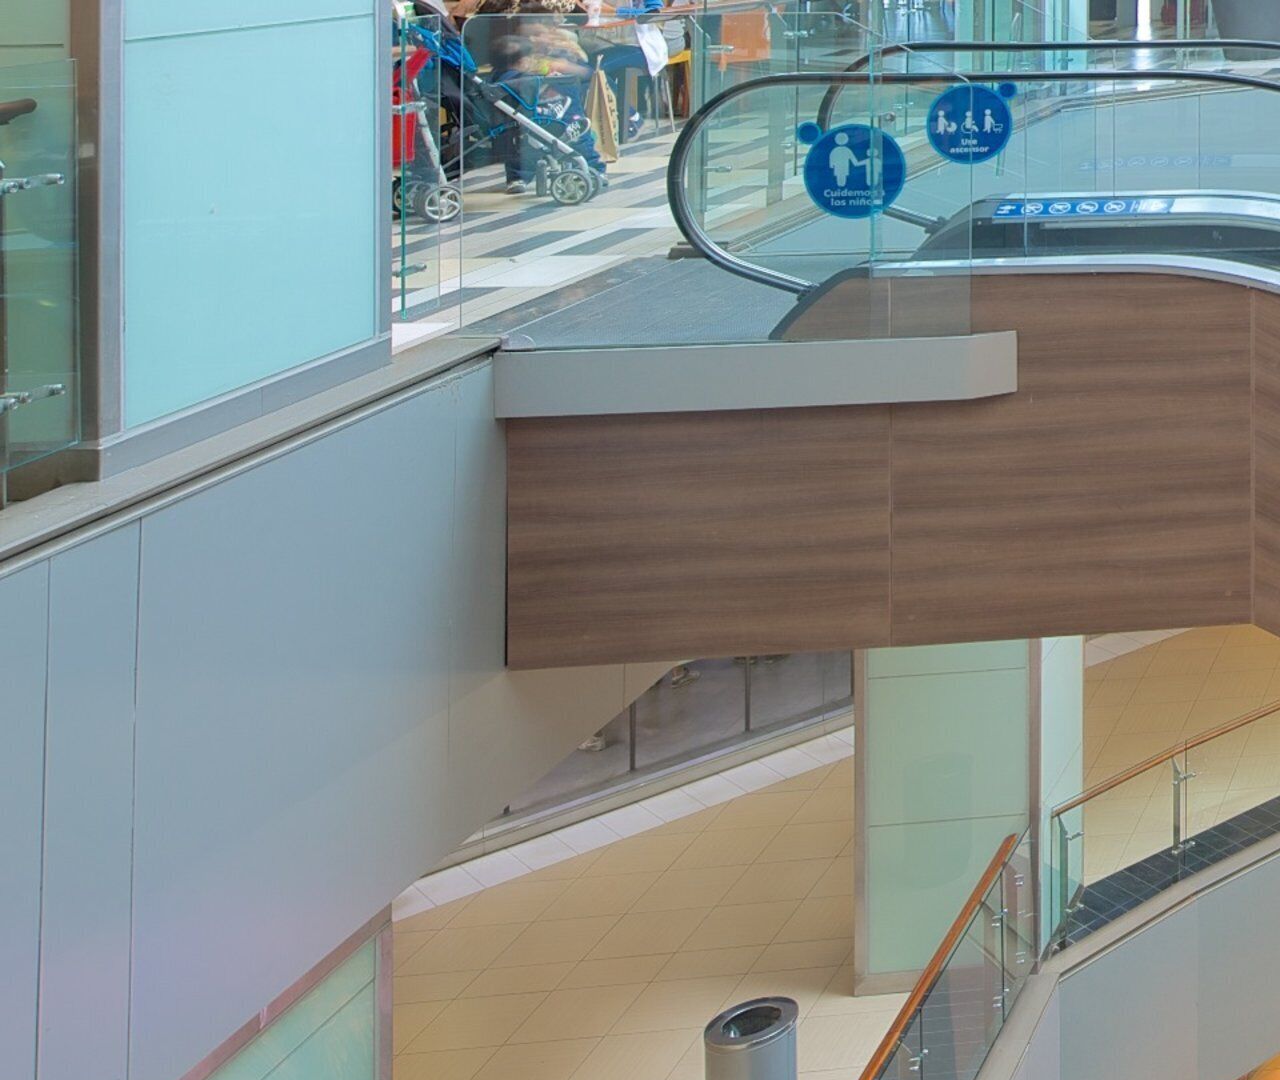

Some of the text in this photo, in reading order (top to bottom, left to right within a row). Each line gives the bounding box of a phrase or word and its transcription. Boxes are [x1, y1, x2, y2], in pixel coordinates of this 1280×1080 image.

[823, 189, 877, 198] Cuidemo
[831, 196, 881, 206] los niño
